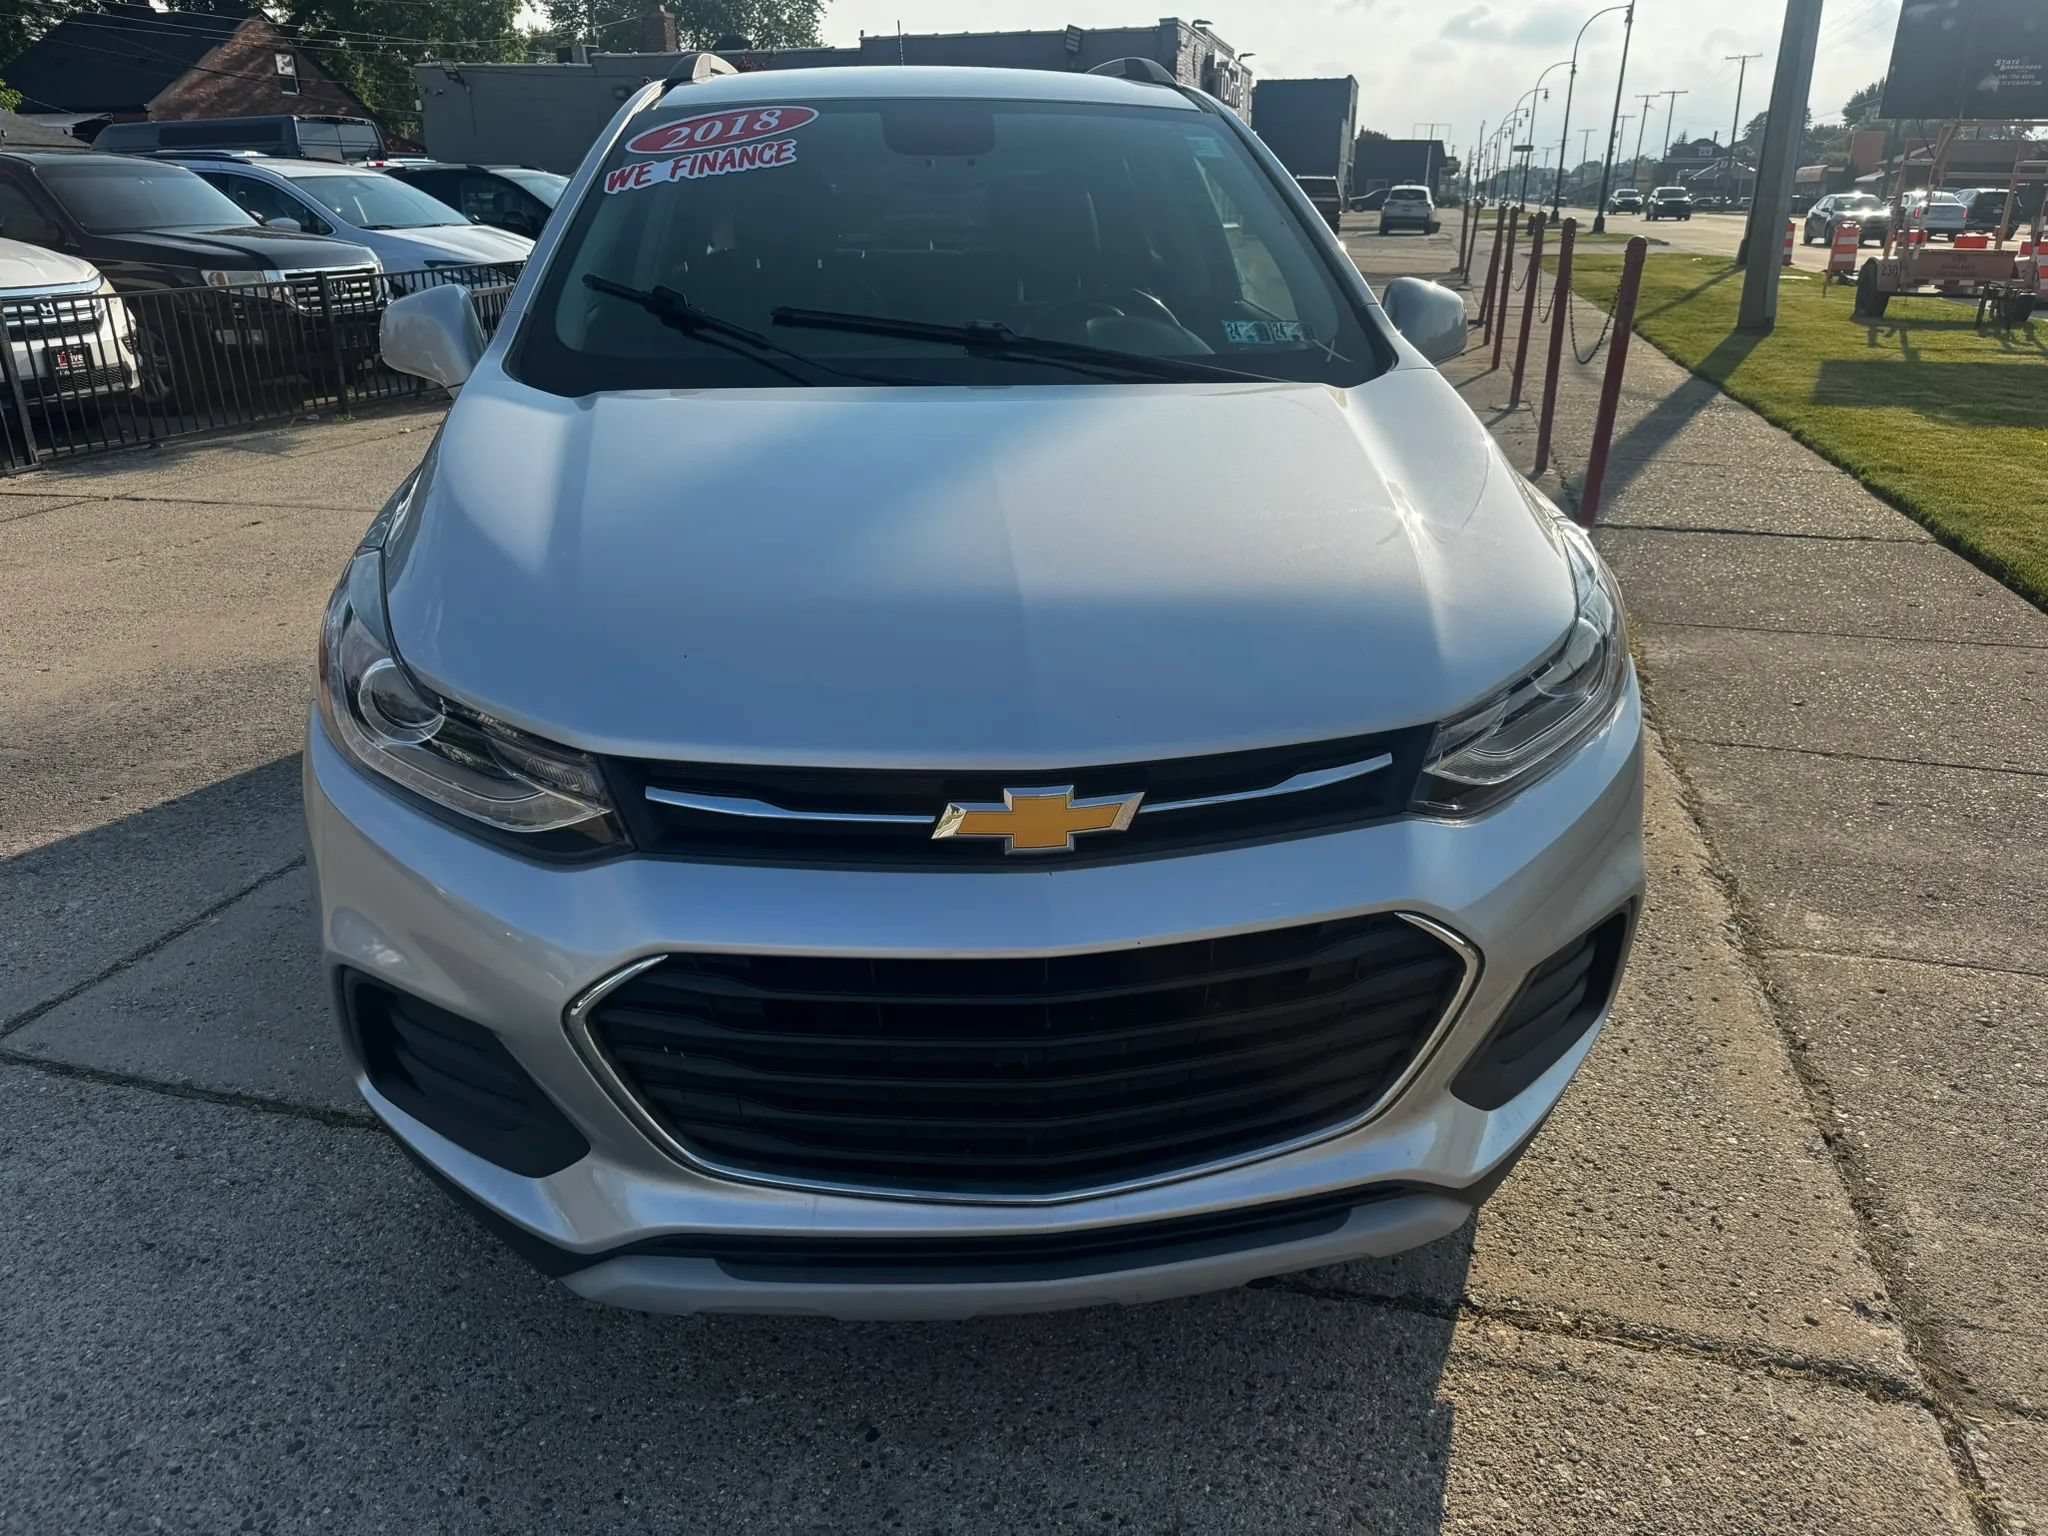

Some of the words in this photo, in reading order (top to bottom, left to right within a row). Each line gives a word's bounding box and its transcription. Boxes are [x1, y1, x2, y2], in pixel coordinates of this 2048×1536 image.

[660, 109, 782, 151] 2018
[607, 163, 653, 192] WE
[670, 141, 796, 180] FINANCE
[1881, 264, 1898, 277] 230
